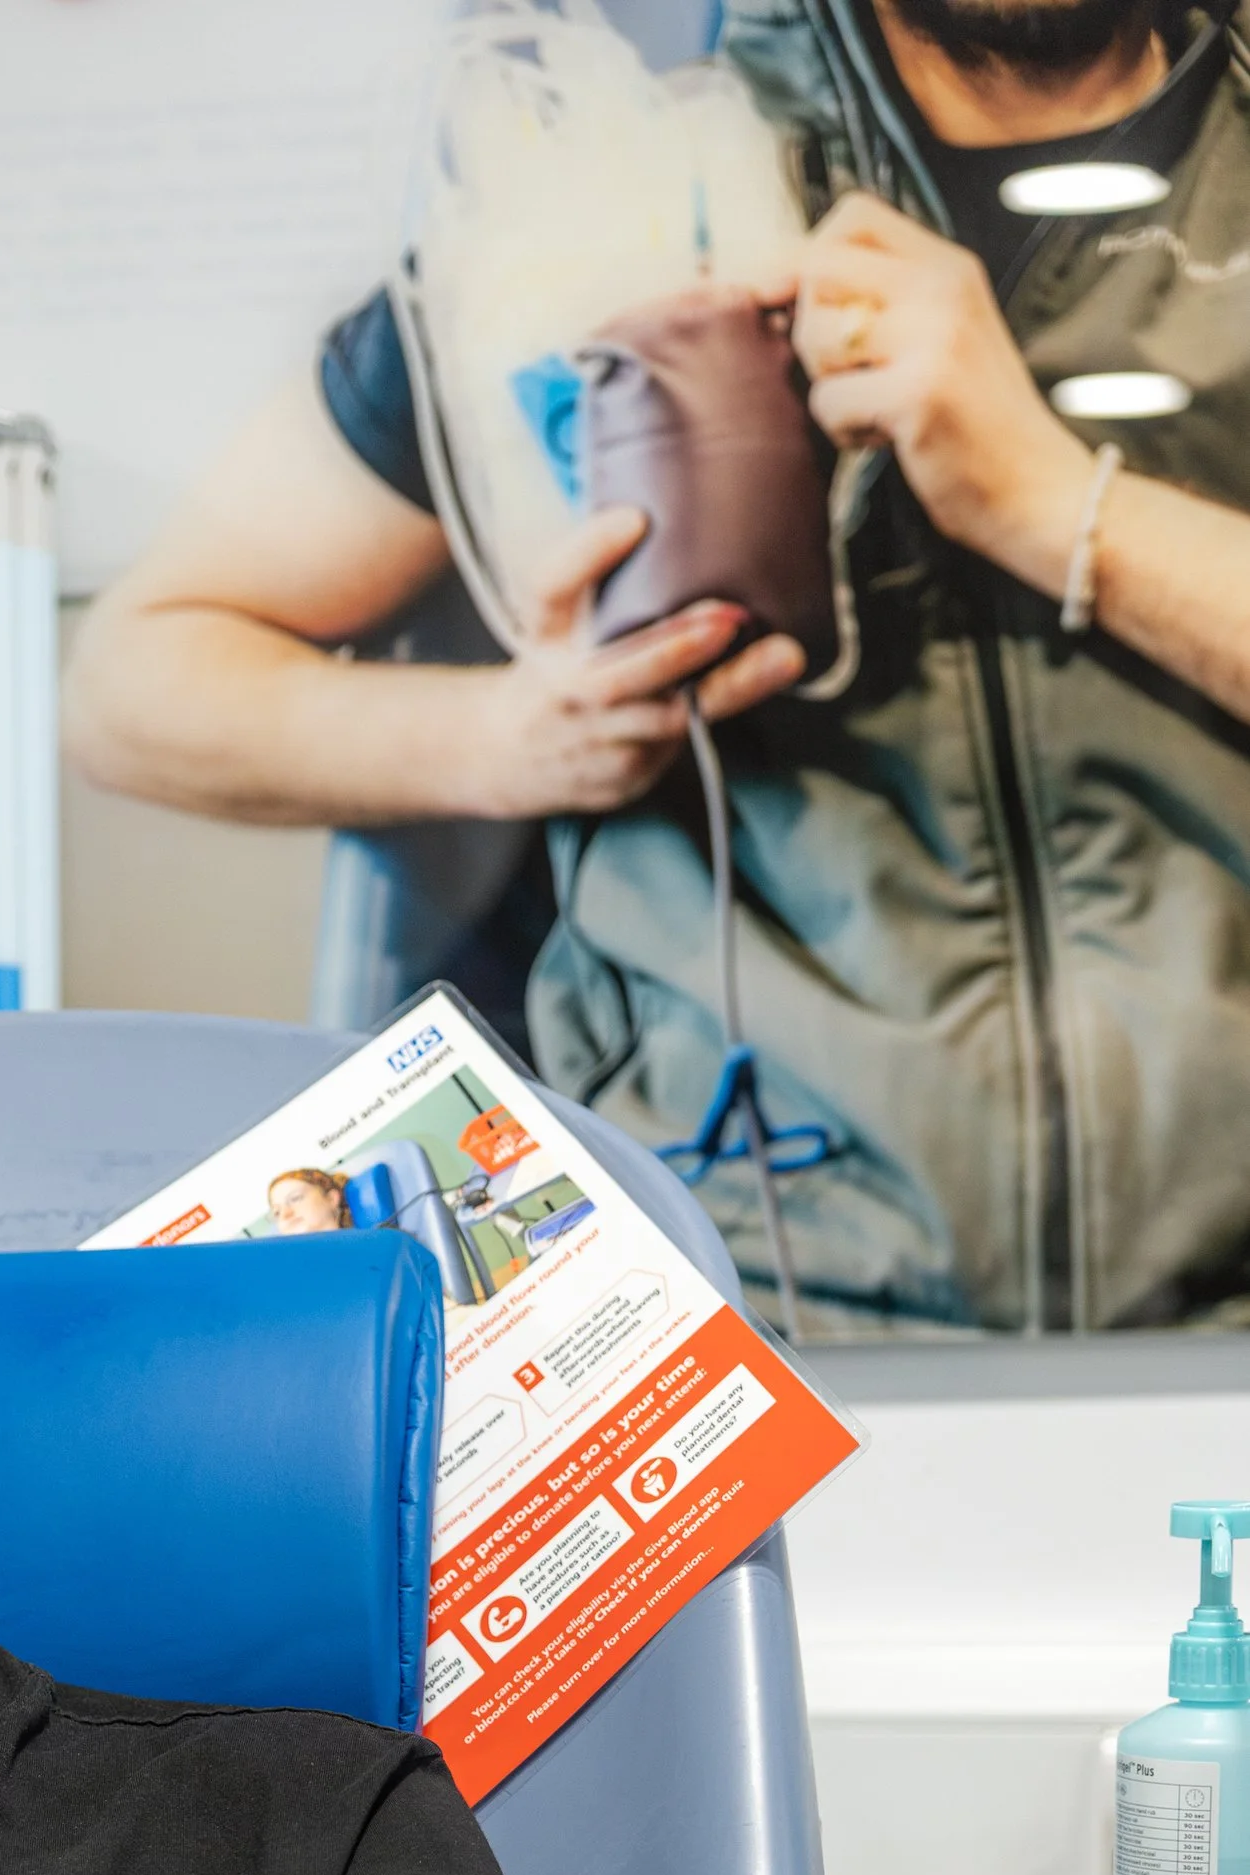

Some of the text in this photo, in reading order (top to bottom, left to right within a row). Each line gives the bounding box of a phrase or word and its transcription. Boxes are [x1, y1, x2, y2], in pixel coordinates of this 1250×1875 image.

[387, 1026, 443, 1070] NHS
[319, 1045, 453, 1148] Blood and Transplant
[440, 1228, 599, 1361] good blood flow round your
[454, 1306, 532, 1373] after donation.
[543, 1296, 620, 1362] Repeat this during
[552, 1299, 630, 1372] your donation, and
[559, 1288, 660, 1379] afterwards when having
[566, 1320, 641, 1388] your refreshments
[519, 1368, 535, 1384] 3
[437, 1510, 467, 1535] raising
[468, 1493, 486, 1511] your
[487, 1477, 505, 1492] legs
[506, 1466, 517, 1478] at
[516, 1455, 531, 1467] the
[532, 1436, 553, 1454] knee
[553, 1425, 563, 1436] or
[564, 1394, 599, 1425] bending
[600, 1376, 618, 1395] your
[620, 1359, 637, 1375] feet
[639, 1349, 648, 1359] at
[648, 1337, 663, 1349] the
[455, 1410, 504, 1453] release over
[674, 1384, 743, 1448] Do you have any
[681, 1396, 743, 1457] planned dental
[687, 1415, 736, 1463] treatments?
[428, 1368, 707, 1622] you are eligible to donate before you next attend:
[444, 1449, 477, 1477] seconds
[457, 1555, 475, 1570] is
[475, 1494, 549, 1559] precious,
[547, 1462, 580, 1491] but
[580, 1444, 600, 1463] so
[600, 1428, 617, 1443] is
[617, 1391, 654, 1431] your
[656, 1356, 695, 1391] time
[519, 1509, 601, 1585] Are you planning to
[525, 1526, 599, 1593] have any cosmetic
[532, 1530, 610, 1603] procedures such as
[539, 1531, 620, 1611] a piercing or tattoo?
[464, 1480, 744, 1744] or blood.co.uk and take the Check if you can donate quiz
[471, 1487, 719, 1717] You can check your eligibility via the Give Blood app
[527, 1547, 713, 1723] Please turn over for more information...
[421, 1658, 461, 1691] xpecting
[424, 1667, 464, 1704] to travel?
[427, 1656, 445, 1673] you
[1136, 1763, 1154, 1777] Plus
